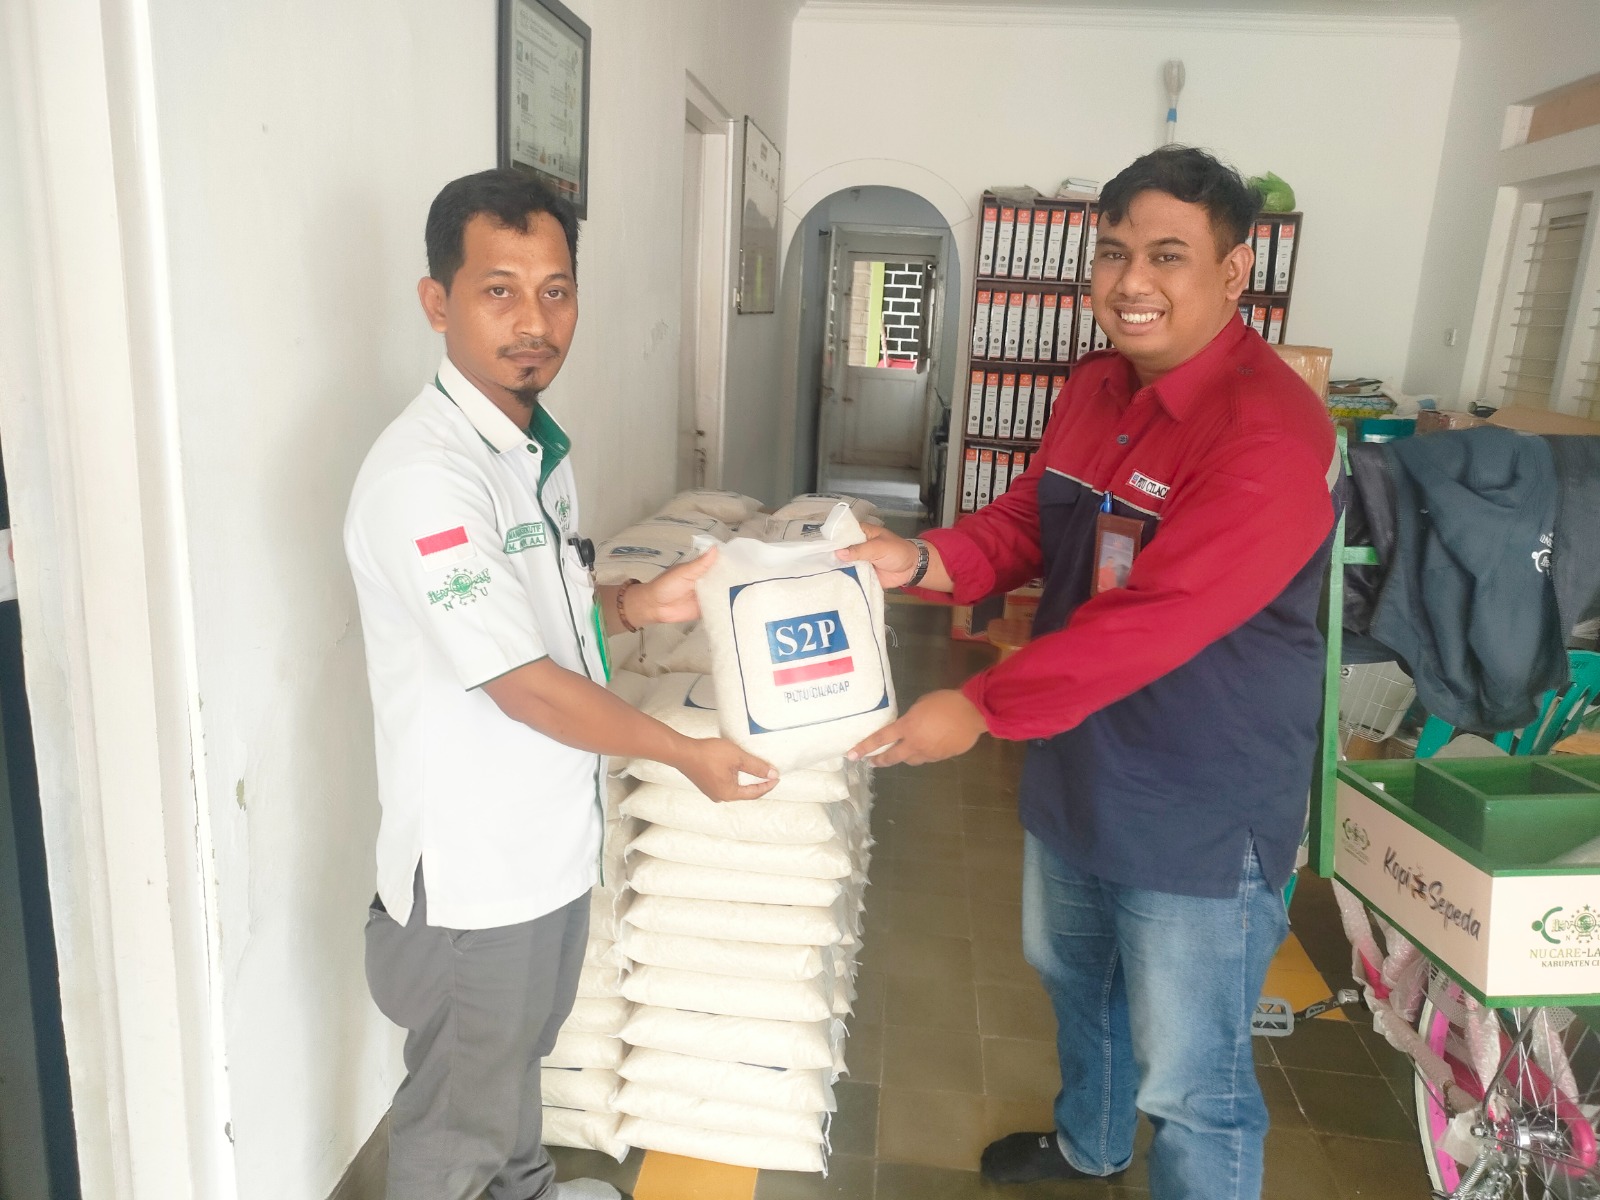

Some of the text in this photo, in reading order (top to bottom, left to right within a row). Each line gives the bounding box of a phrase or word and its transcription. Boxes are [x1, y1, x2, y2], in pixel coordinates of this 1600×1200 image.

[776, 620, 835, 656] S2P
[811, 681, 850, 699] CILACAP
[1384, 846, 1412, 896] Kopi
[1428, 880, 1482, 941] Sepeda
[1530, 949, 1547, 958] NU
